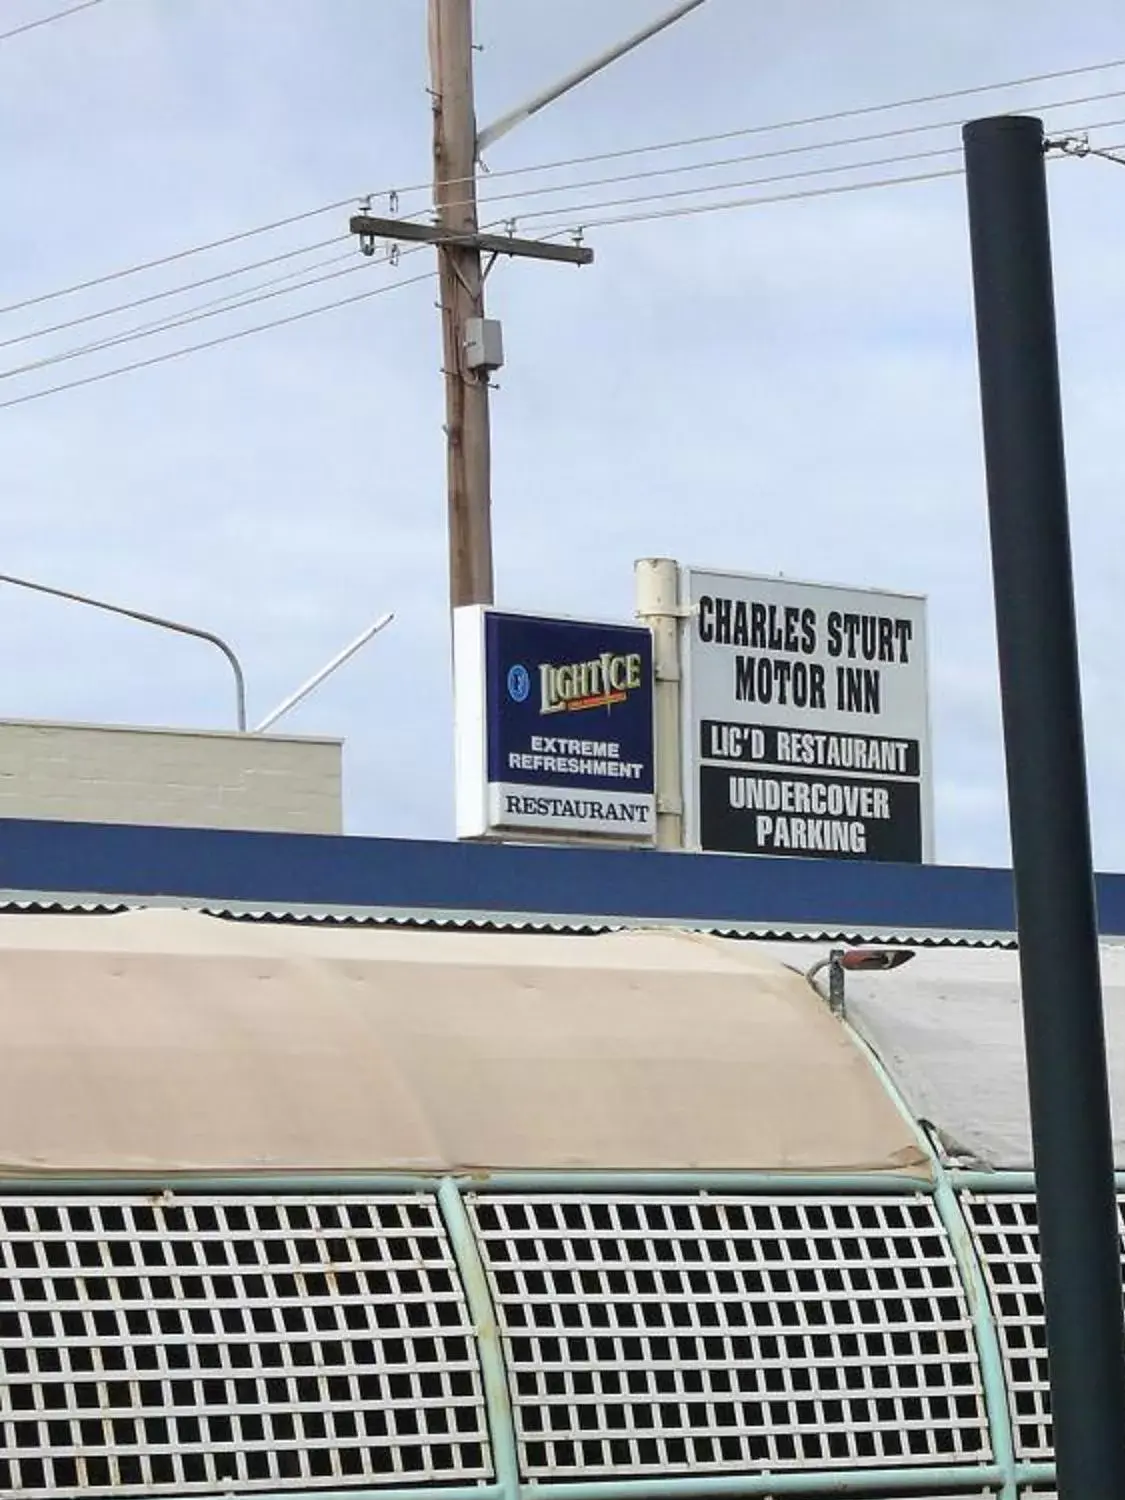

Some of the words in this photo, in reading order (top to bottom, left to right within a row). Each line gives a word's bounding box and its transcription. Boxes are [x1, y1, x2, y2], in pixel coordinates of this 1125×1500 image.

[699, 595, 816, 654] CHARLES
[827, 611, 912, 663] STURT
[735, 655, 826, 709] MOTOR
[837, 667, 880, 715] INN
[509, 753, 643, 779] REFRESHMENT
[531, 736, 619, 757] EXTREME
[711, 725, 765, 760] LIC'D
[777, 731, 908, 772] RESTAURANT
[506, 795, 648, 823] RESTAURANT
[729, 776, 890, 820] UNDERCOVER
[756, 815, 866, 853] PARKING
